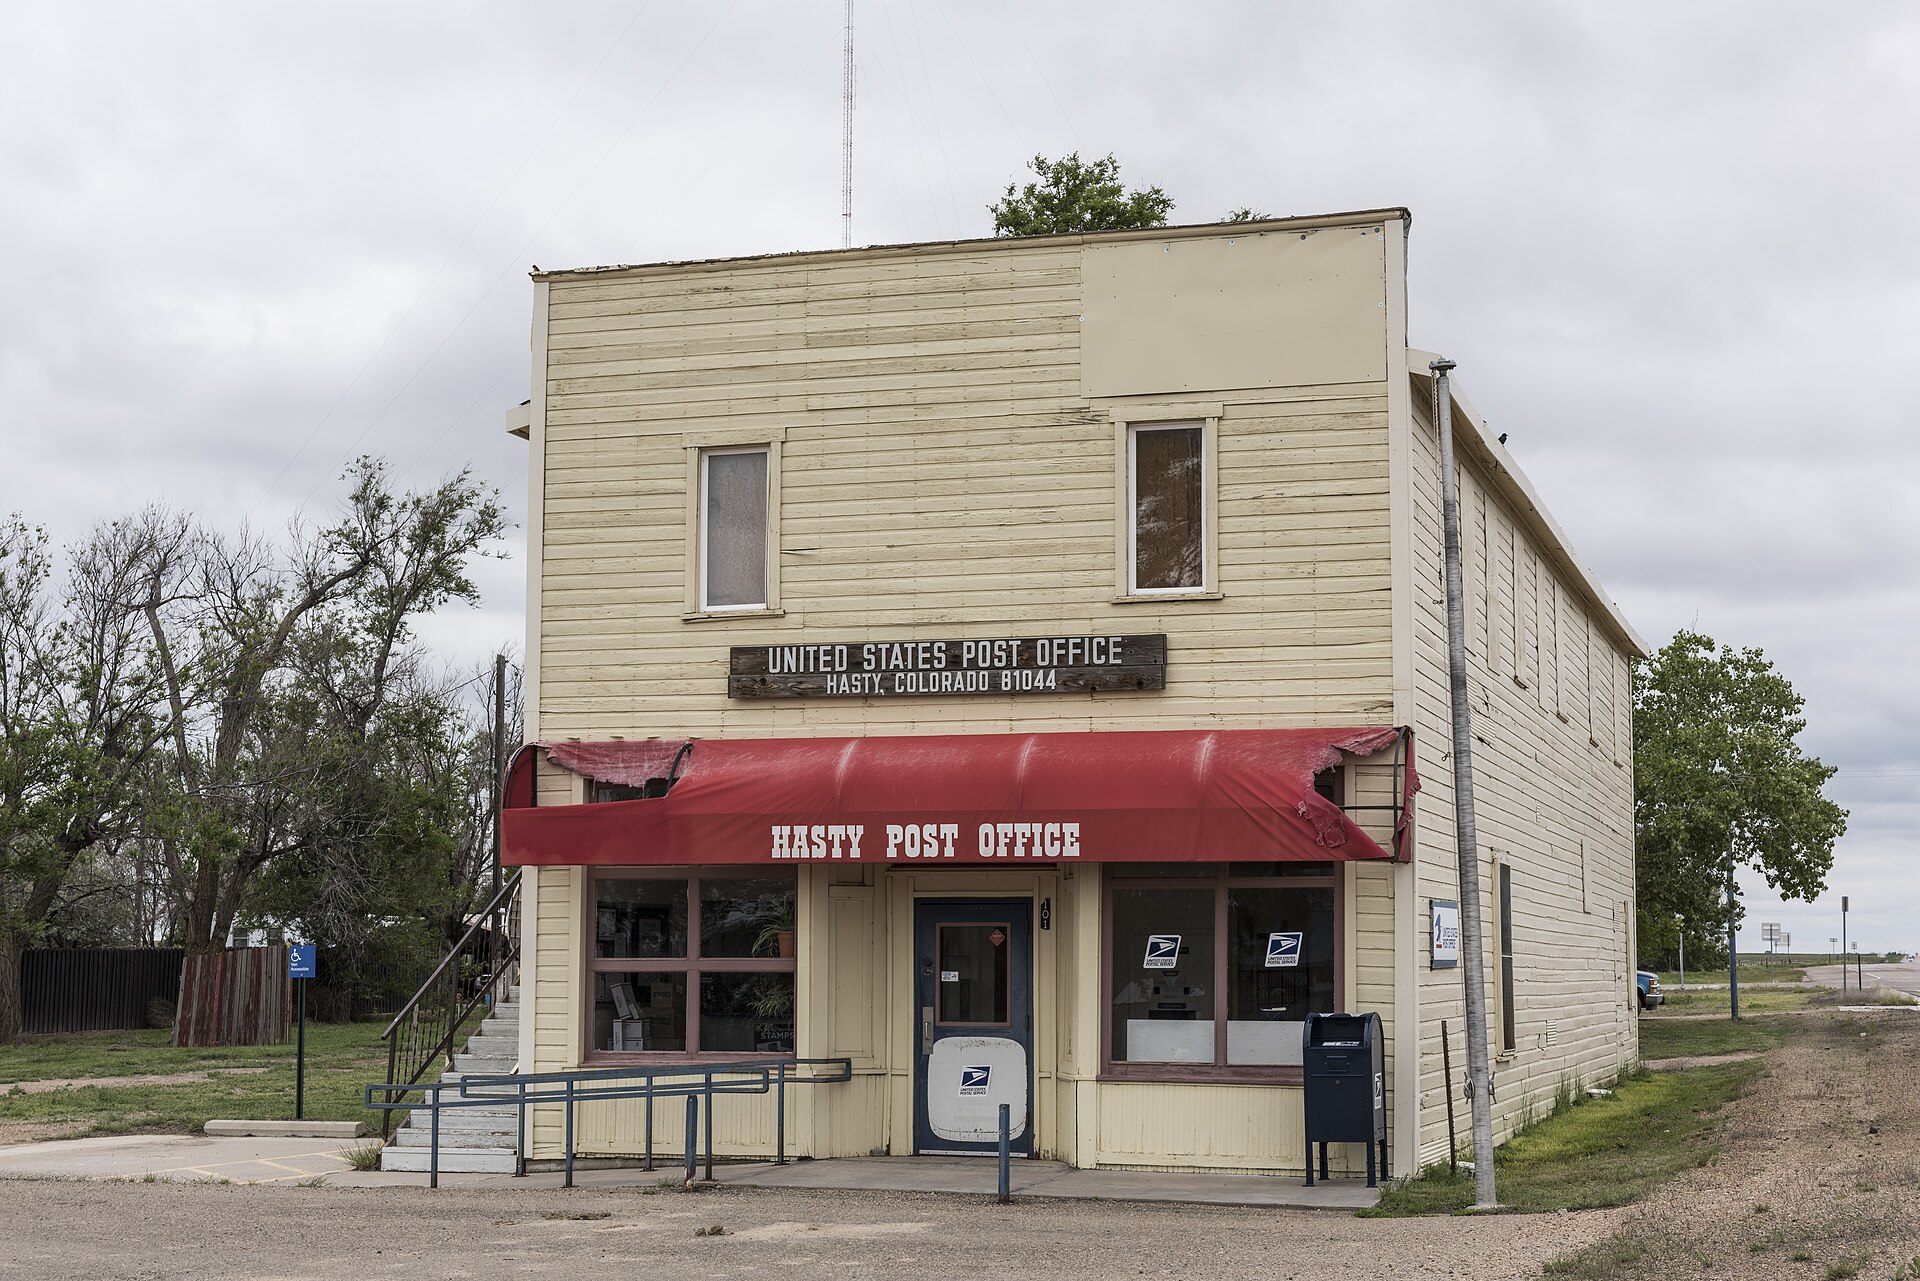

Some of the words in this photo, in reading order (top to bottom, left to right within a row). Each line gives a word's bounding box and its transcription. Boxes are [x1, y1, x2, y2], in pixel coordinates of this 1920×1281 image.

[768, 645, 848, 674] UNITED
[863, 640, 947, 672] STATES
[962, 640, 1021, 668] POST
[1037, 636, 1122, 666] OFFICE
[826, 673, 885, 696] HASTY,
[894, 671, 989, 693] COLORADO
[1001, 669, 1057, 691] 81044
[771, 824, 864, 859] HASTY
[886, 823, 959, 858] POST
[978, 822, 1080, 857] OFFICE
